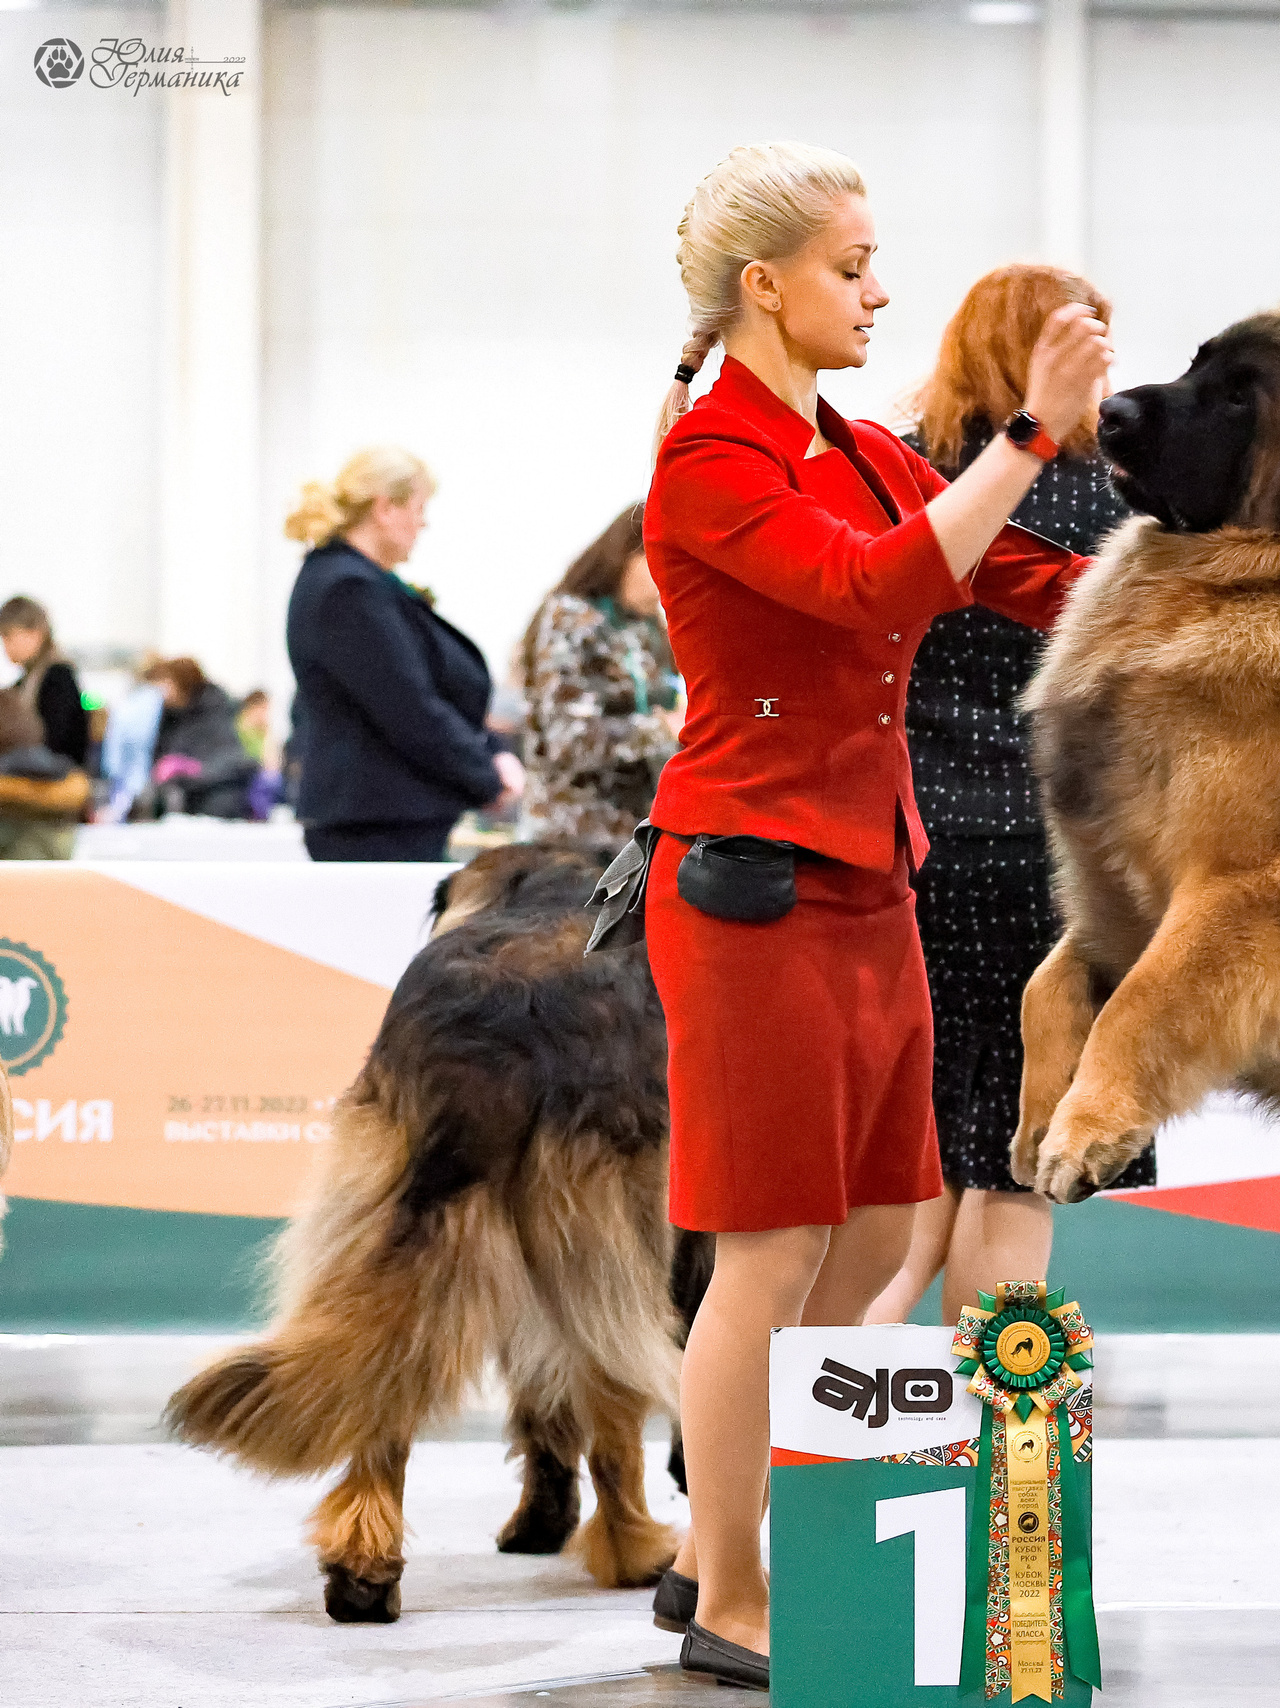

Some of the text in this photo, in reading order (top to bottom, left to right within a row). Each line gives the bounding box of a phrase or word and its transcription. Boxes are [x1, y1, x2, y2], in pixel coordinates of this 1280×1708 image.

[1015, 1571, 1043, 1579] КУБОК
[875, 1486, 966, 1686] 1
[1012, 1580, 1046, 1588] МОСКВЫ
[1019, 1590, 1040, 1598] 2022
[1012, 1620, 1048, 1628] ПОБЕДИТЕЛЬ
[1016, 1630, 1045, 1638] КЛАССА
